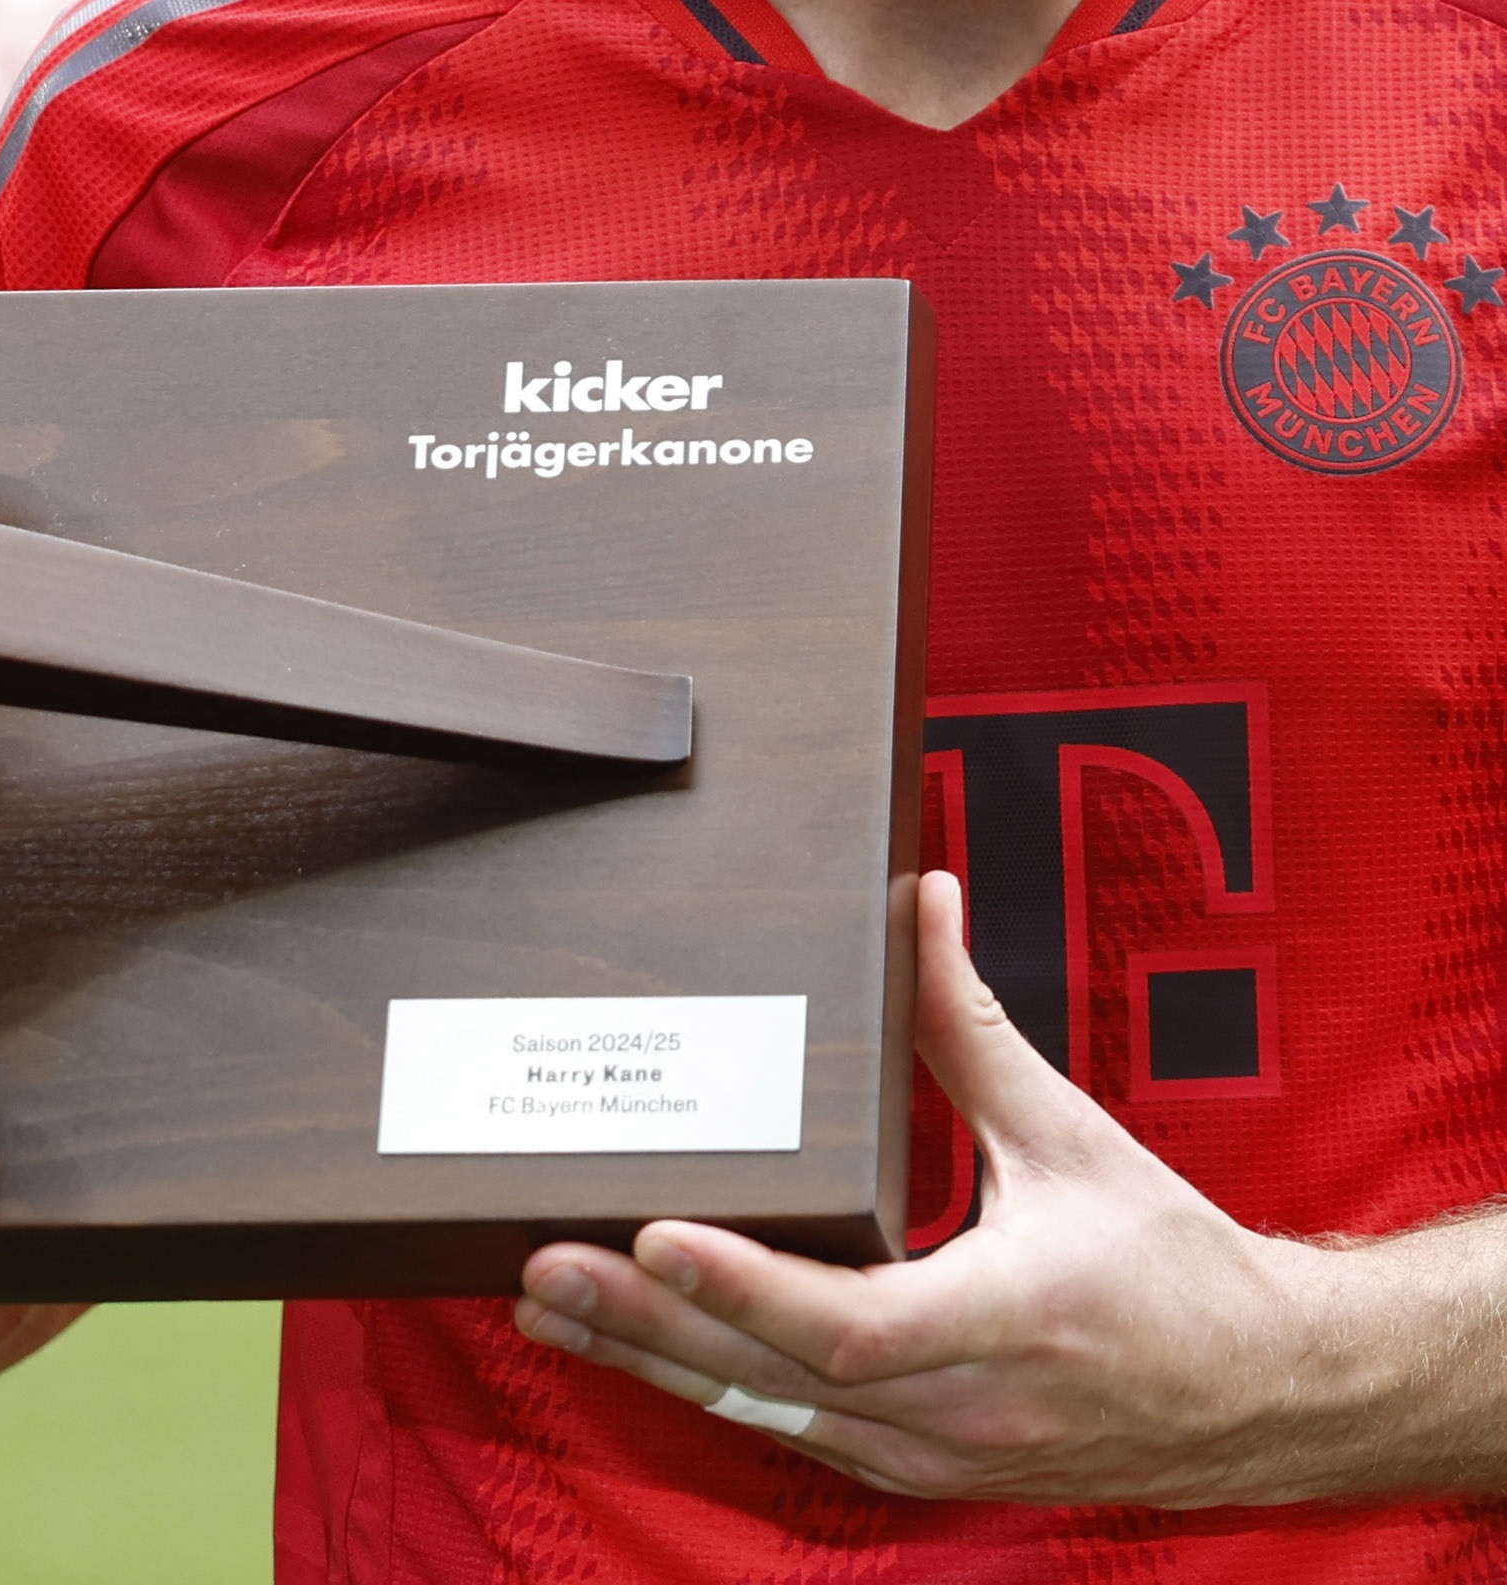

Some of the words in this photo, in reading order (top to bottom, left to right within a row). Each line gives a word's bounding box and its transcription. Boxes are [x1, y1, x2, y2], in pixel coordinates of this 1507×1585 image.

[1242, 296, 1288, 346] FC
[1288, 266, 1441, 347] BAYERN
[503, 359, 723, 414] kicker
[1244, 381, 1441, 458] MÜNCHEN
[408, 428, 815, 479] Torjägerkanone
[511, 1034, 582, 1053] Saison
[587, 1031, 682, 1054] 2024/25
[527, 1065, 595, 1086] Harry
[603, 1064, 663, 1083] Kane
[488, 1096, 516, 1115] FC
[521, 1095, 592, 1118] Bayern
[599, 1093, 698, 1114] München
